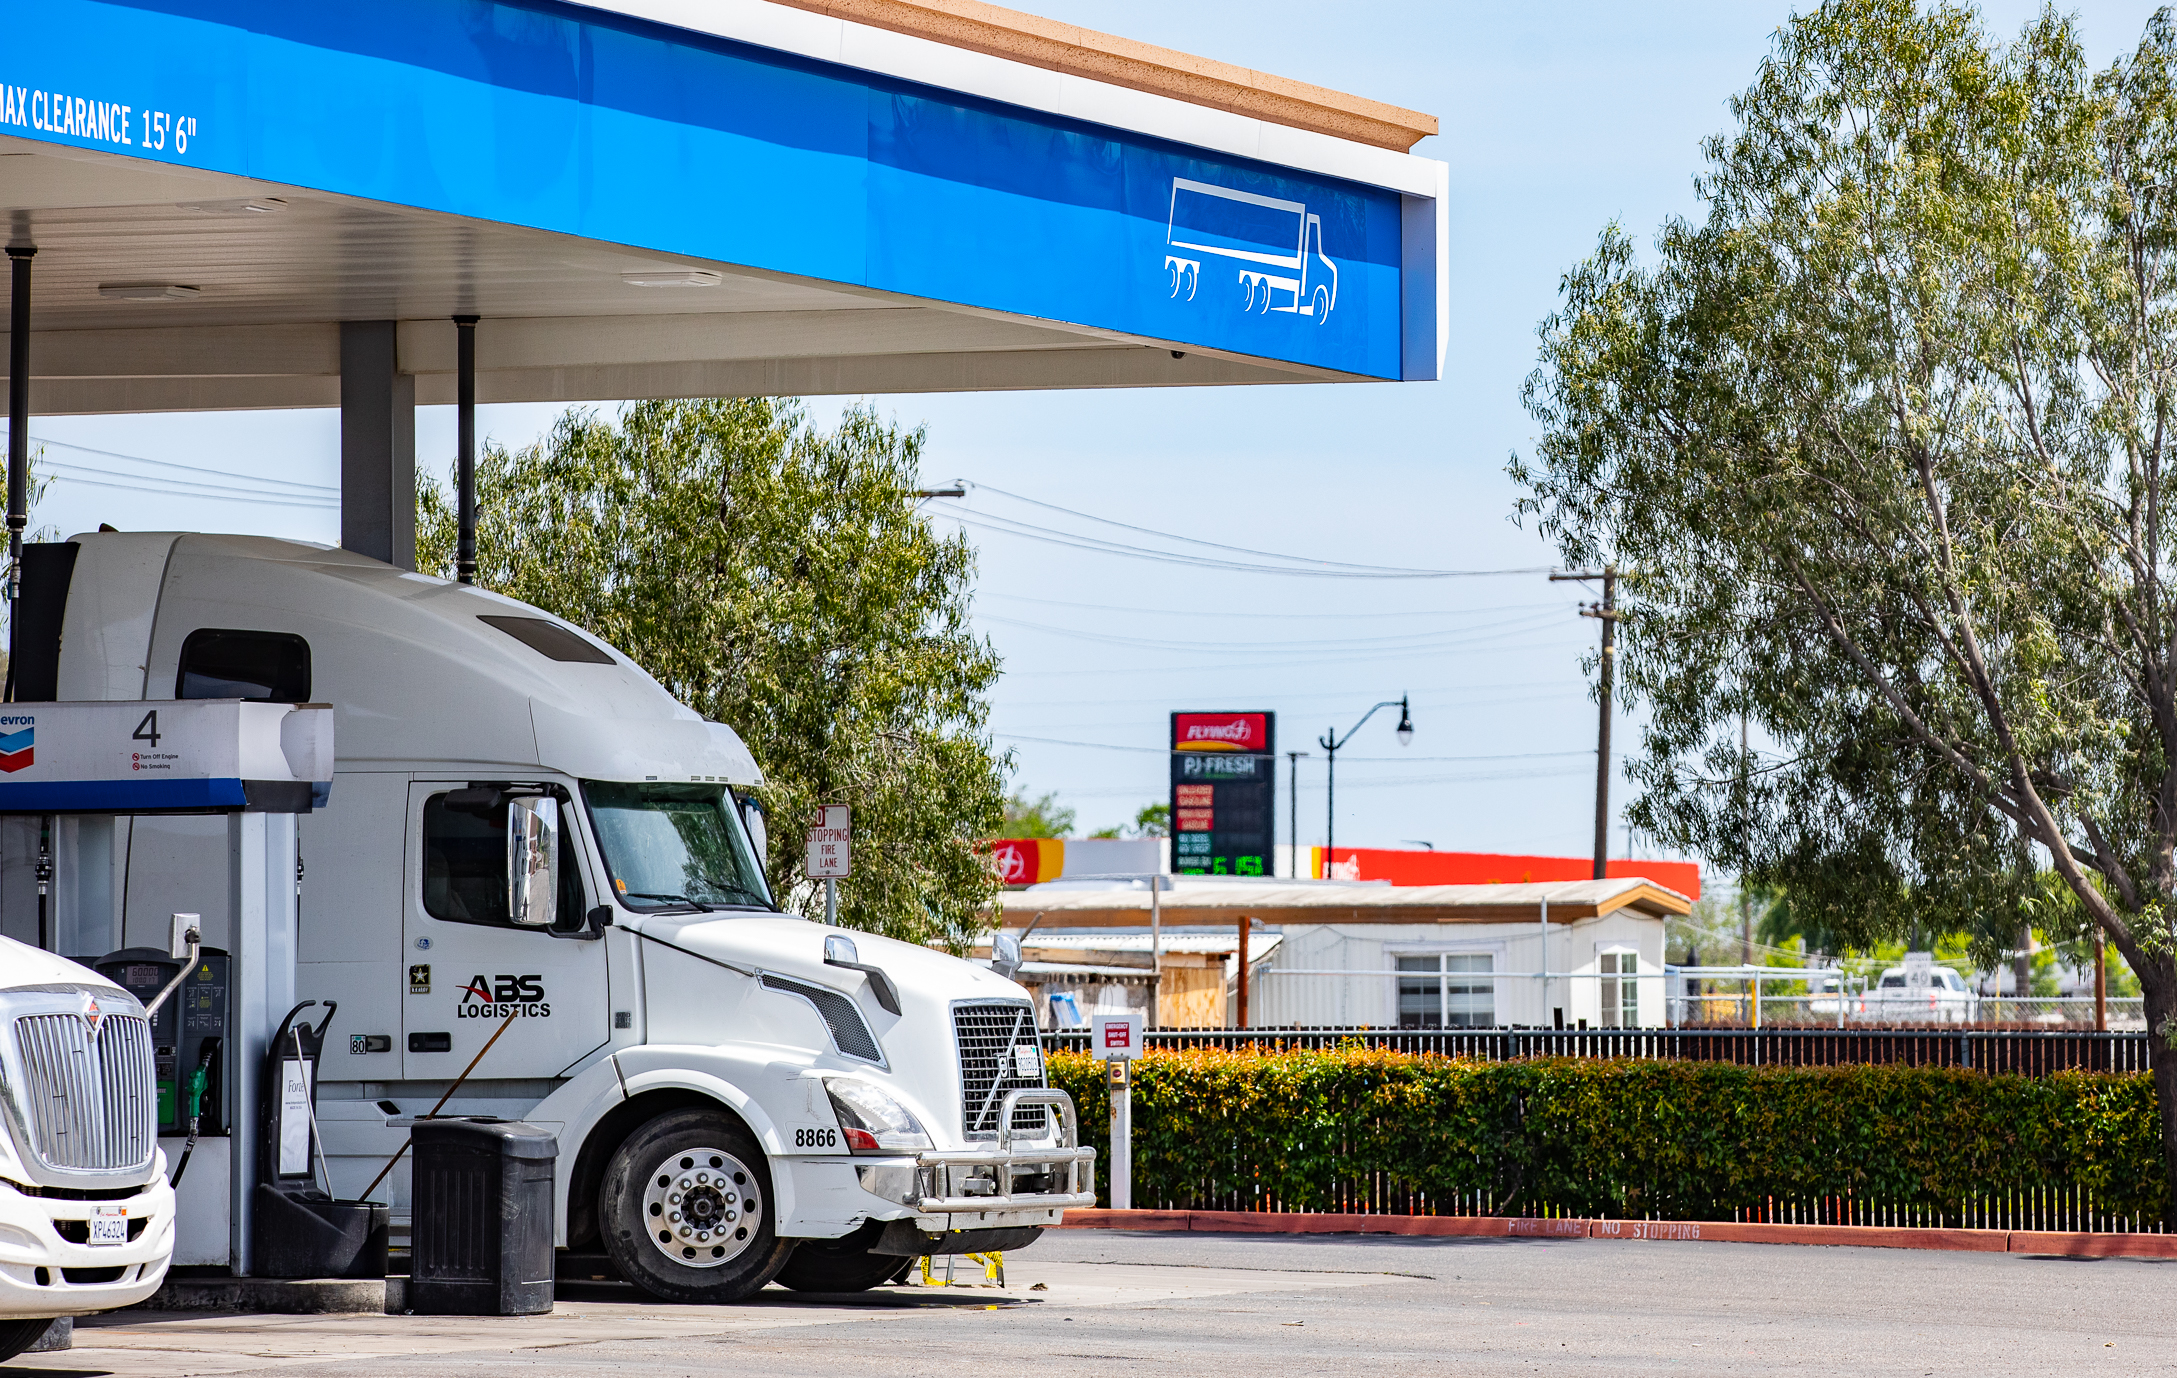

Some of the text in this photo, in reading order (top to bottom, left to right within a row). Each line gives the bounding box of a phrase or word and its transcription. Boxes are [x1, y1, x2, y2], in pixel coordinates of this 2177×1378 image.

[32, 89, 132, 145] CLEARANCE
[142, 109, 171, 151] 15'
[175, 115, 197, 154] 6"
[132, 709, 161, 748] 4
[1205, 756, 1256, 775] FRESH
[808, 828, 847, 842] STOPPING
[821, 844, 836, 855] FIRE
[819, 857, 838, 868] LANE
[455, 974, 545, 1003] ABS
[457, 1003, 551, 1019] LOGISTICS
[352, 1040, 365, 1053] 80
[795, 1128, 836, 1148] 8866
[93, 1220, 125, 1239] XP46324
[1508, 1219, 1582, 1234] FIRE LANE
[1601, 1221, 1701, 1239] NO STOPPING
